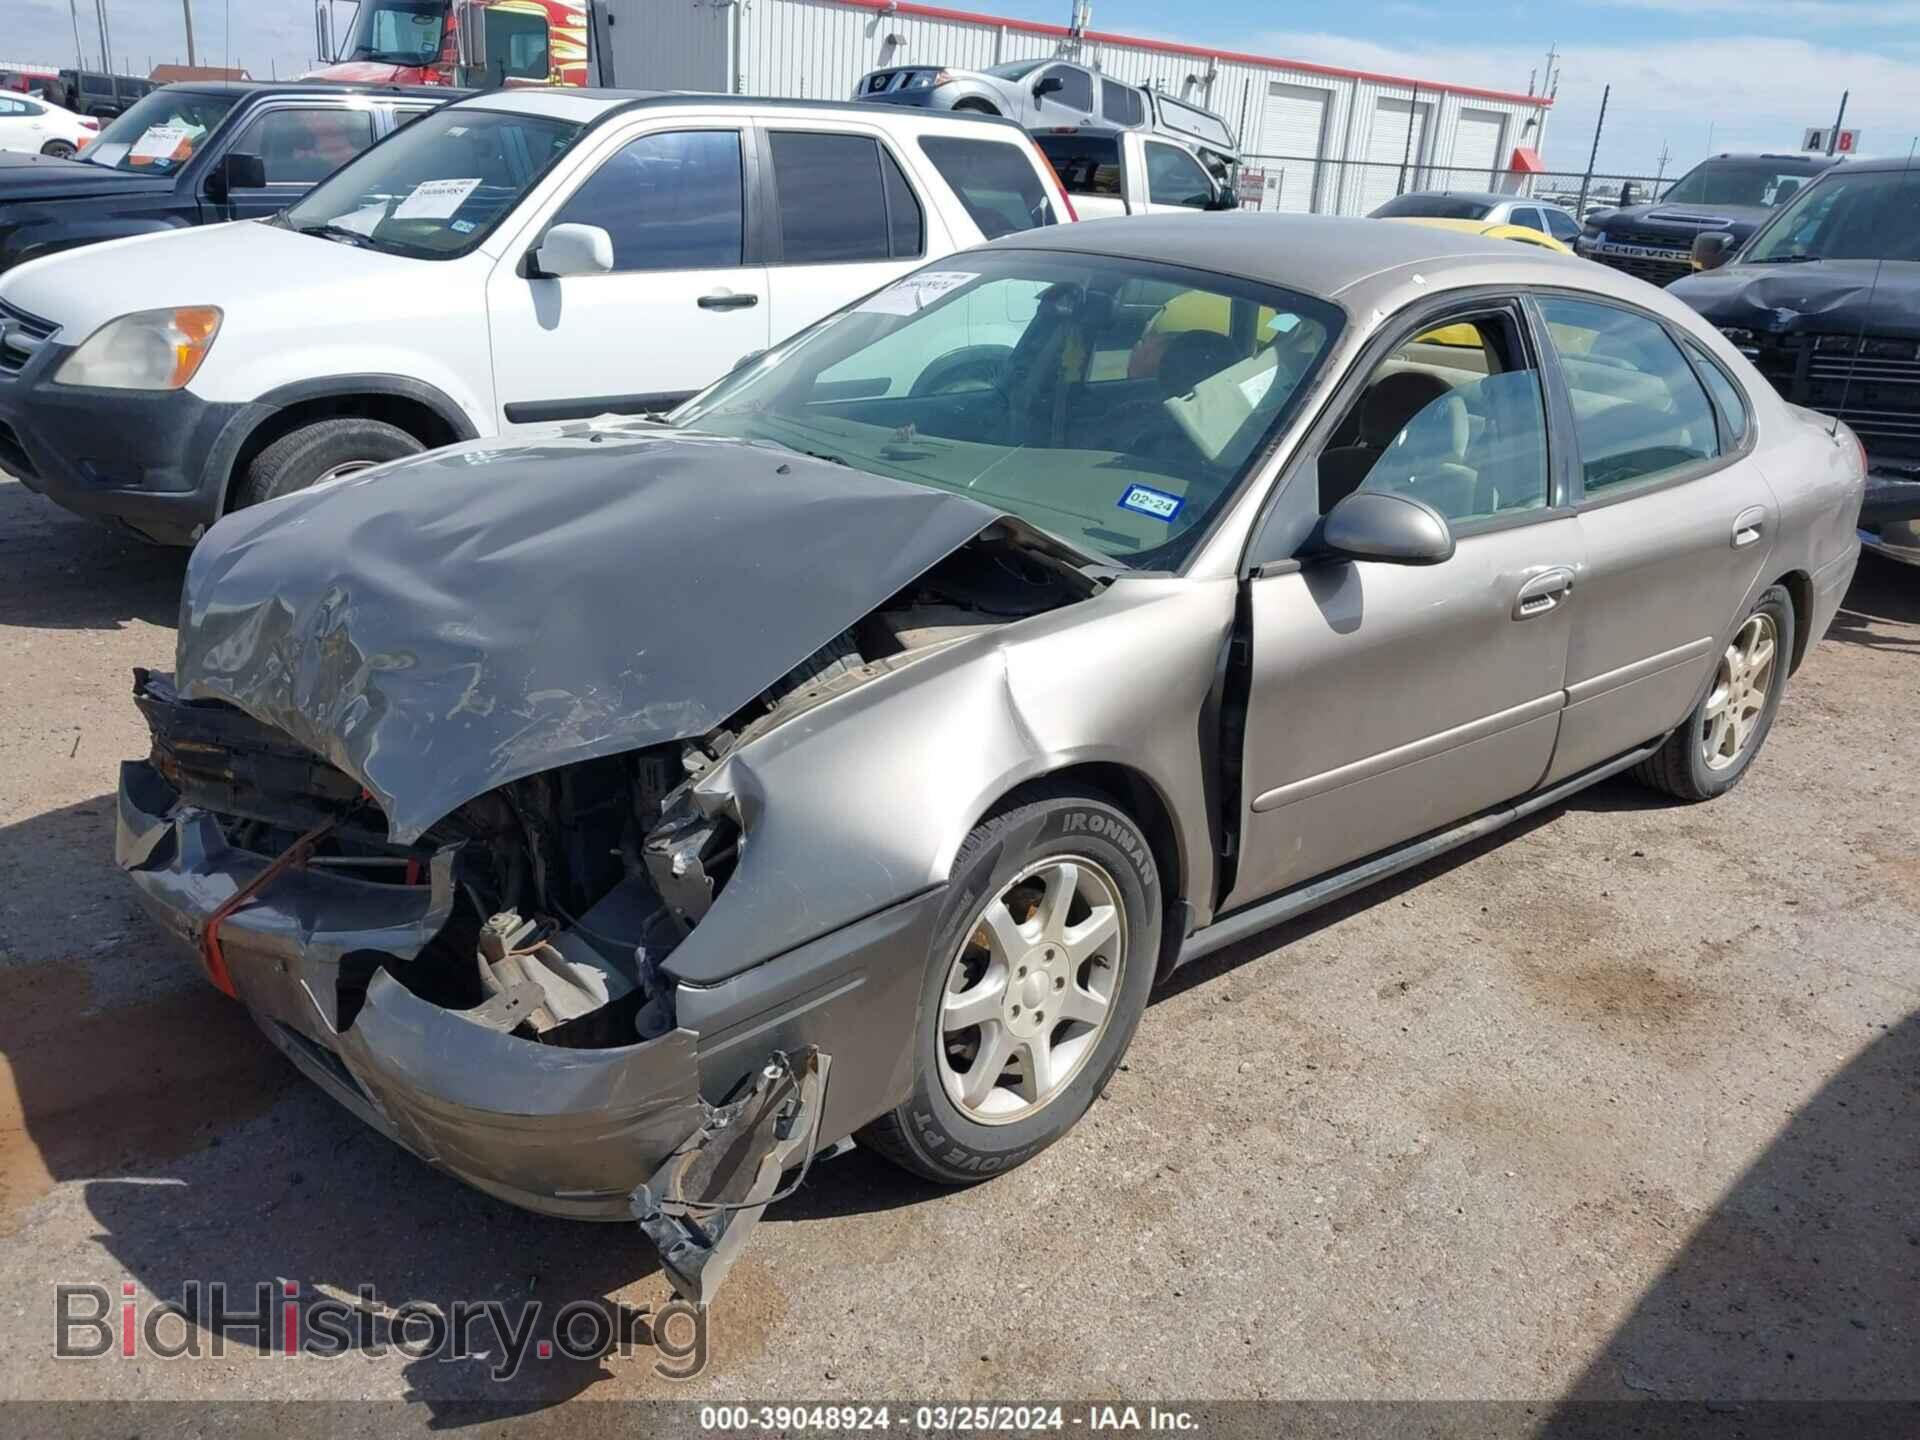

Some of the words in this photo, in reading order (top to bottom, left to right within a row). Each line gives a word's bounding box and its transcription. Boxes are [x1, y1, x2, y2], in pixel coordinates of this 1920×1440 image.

[1808, 131, 1821, 150] A
[1839, 132, 1852, 151] B
[1602, 244, 1690, 260] CHEVRO
[1062, 812, 1154, 885] IRONMAN
